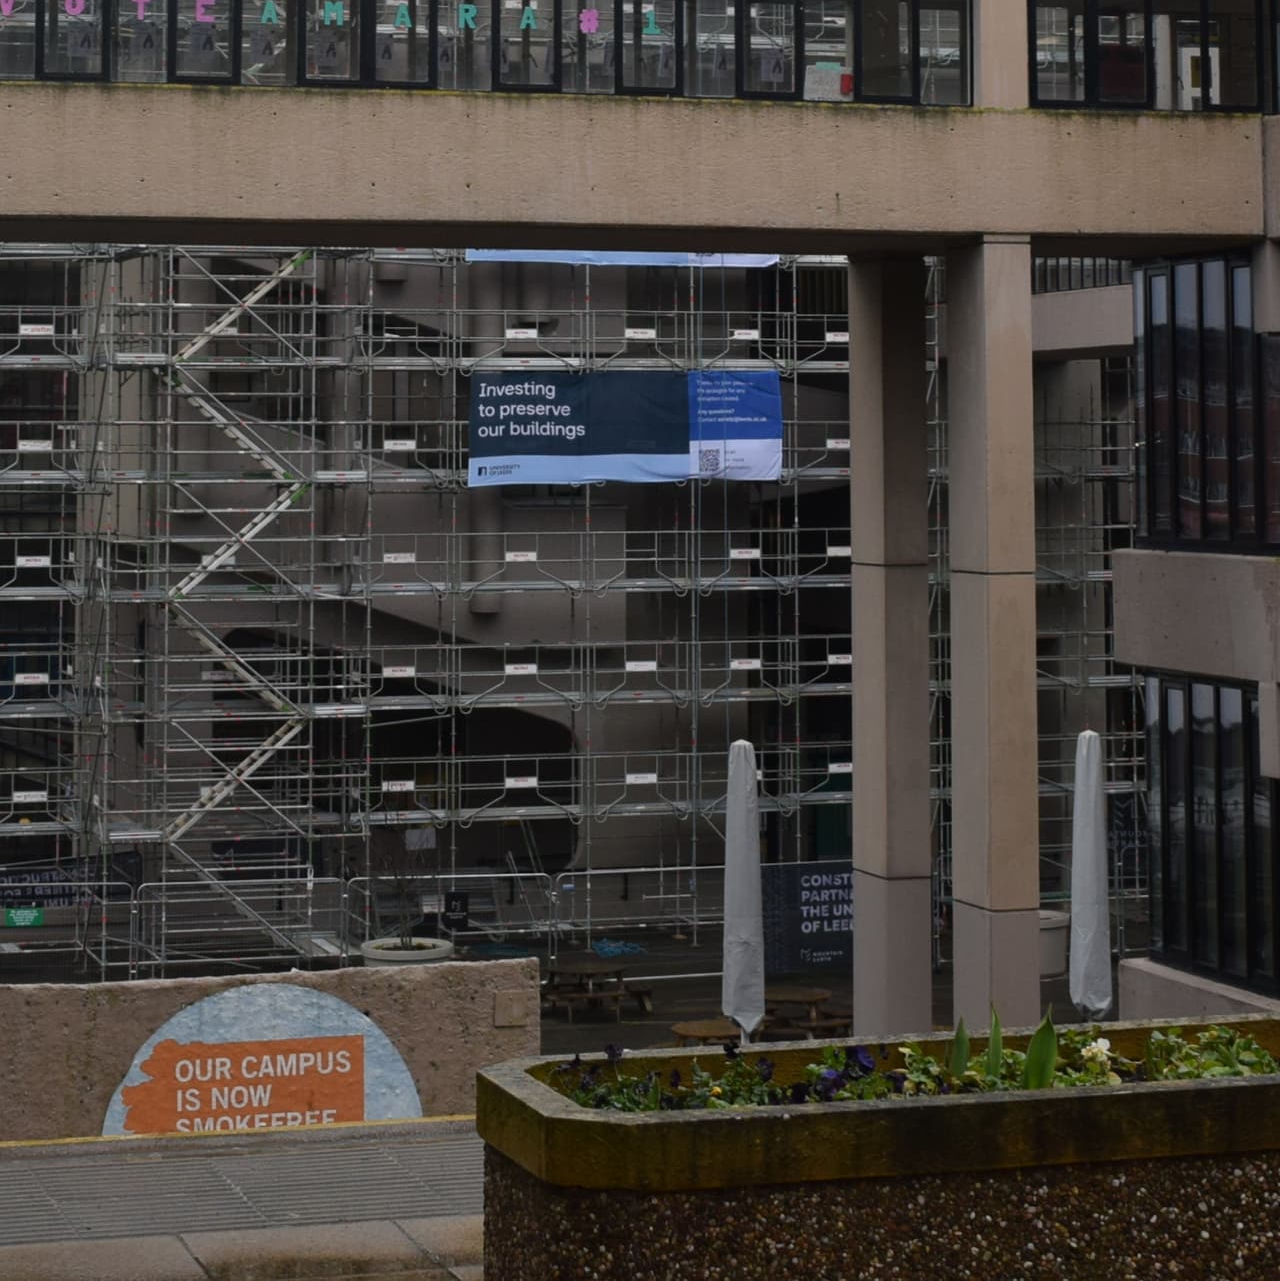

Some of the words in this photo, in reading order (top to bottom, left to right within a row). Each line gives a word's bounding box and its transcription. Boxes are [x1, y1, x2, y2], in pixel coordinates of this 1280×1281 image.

[261, 0, 537, 29] AMARA
[479, 381, 556, 400] Investing
[478, 404, 495, 417] to
[500, 403, 571, 419] preserve
[478, 425, 505, 437] our
[510, 421, 585, 440] buildings
[800, 905, 830, 918] THE
[801, 921, 821, 933] OF
[175, 1057, 232, 1083] OUR
[241, 1050, 352, 1078] CAMPUS
[176, 1088, 201, 1112] IS
[211, 1084, 273, 1109] NOW
